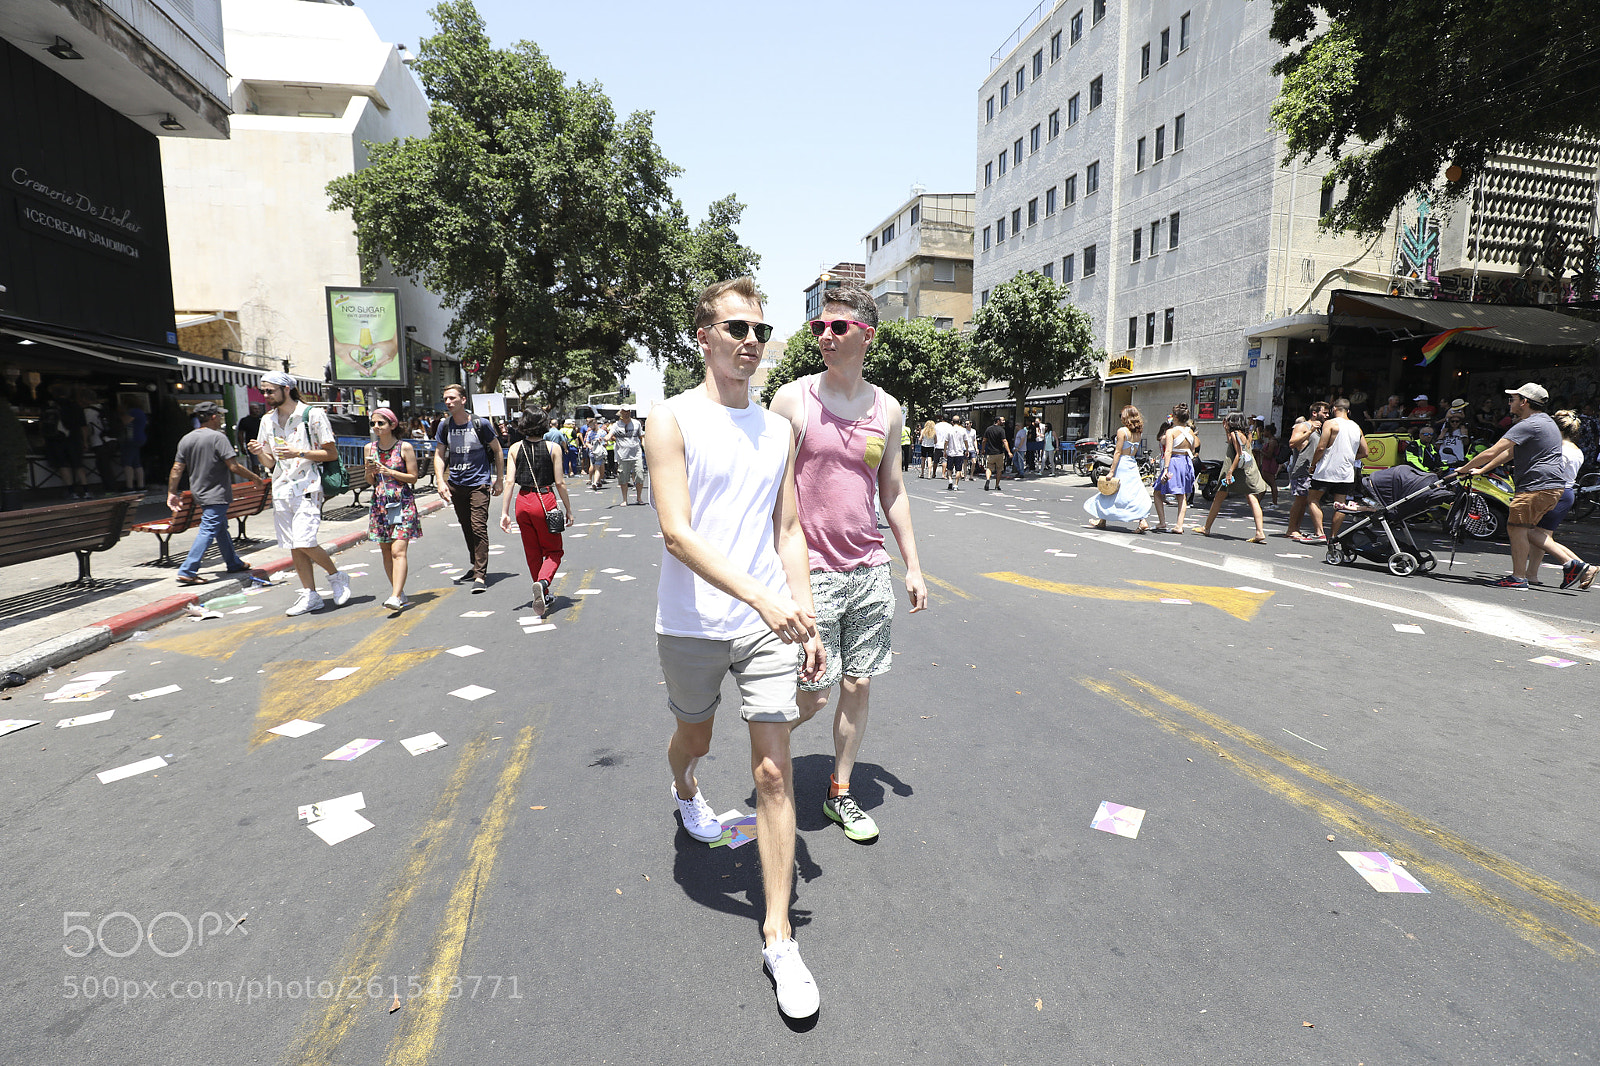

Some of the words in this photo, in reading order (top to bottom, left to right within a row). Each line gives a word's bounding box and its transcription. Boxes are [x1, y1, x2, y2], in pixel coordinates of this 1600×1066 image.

[11, 167, 75, 206] Cremerie
[75, 192, 98, 215] De
[24, 207, 87, 239] ICECREAM
[88, 231, 139, 258] SANDWICH
[341, 305, 355, 313] NO
[455, 445, 471, 454] GET
[453, 462, 472, 471] LOST
